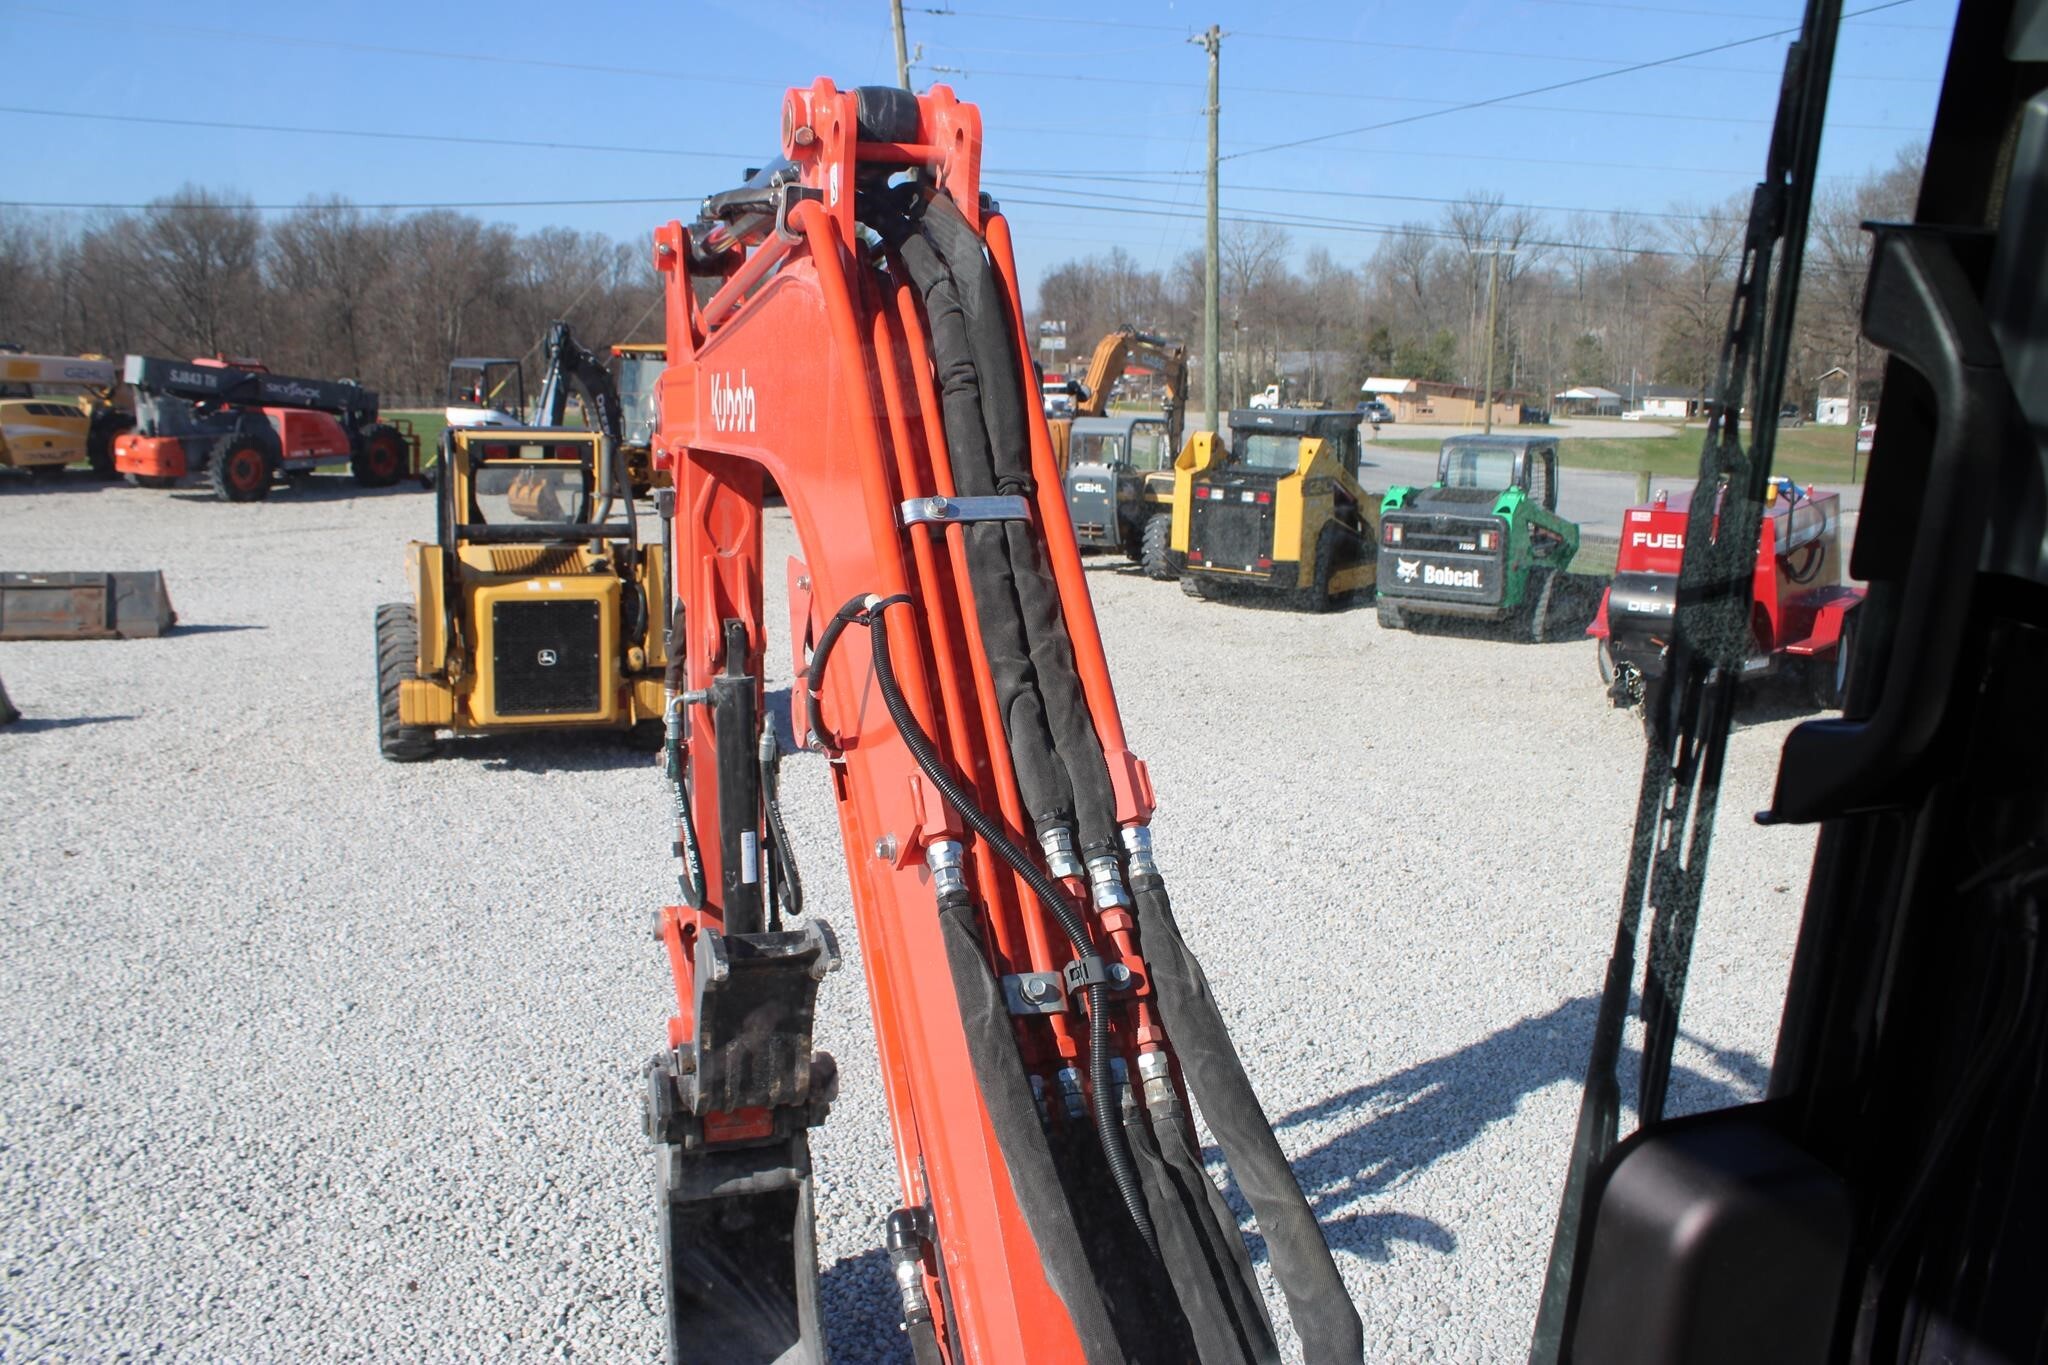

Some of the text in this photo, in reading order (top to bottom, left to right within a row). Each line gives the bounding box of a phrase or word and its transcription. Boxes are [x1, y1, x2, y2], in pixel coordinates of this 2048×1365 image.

[266, 382, 320, 398] SKYJACK
[711, 368, 756, 433] Kubota
[1075, 483, 1106, 493] GEHL
[1632, 532, 1685, 549] FUEL
[1627, 601, 1661, 613] DEF
